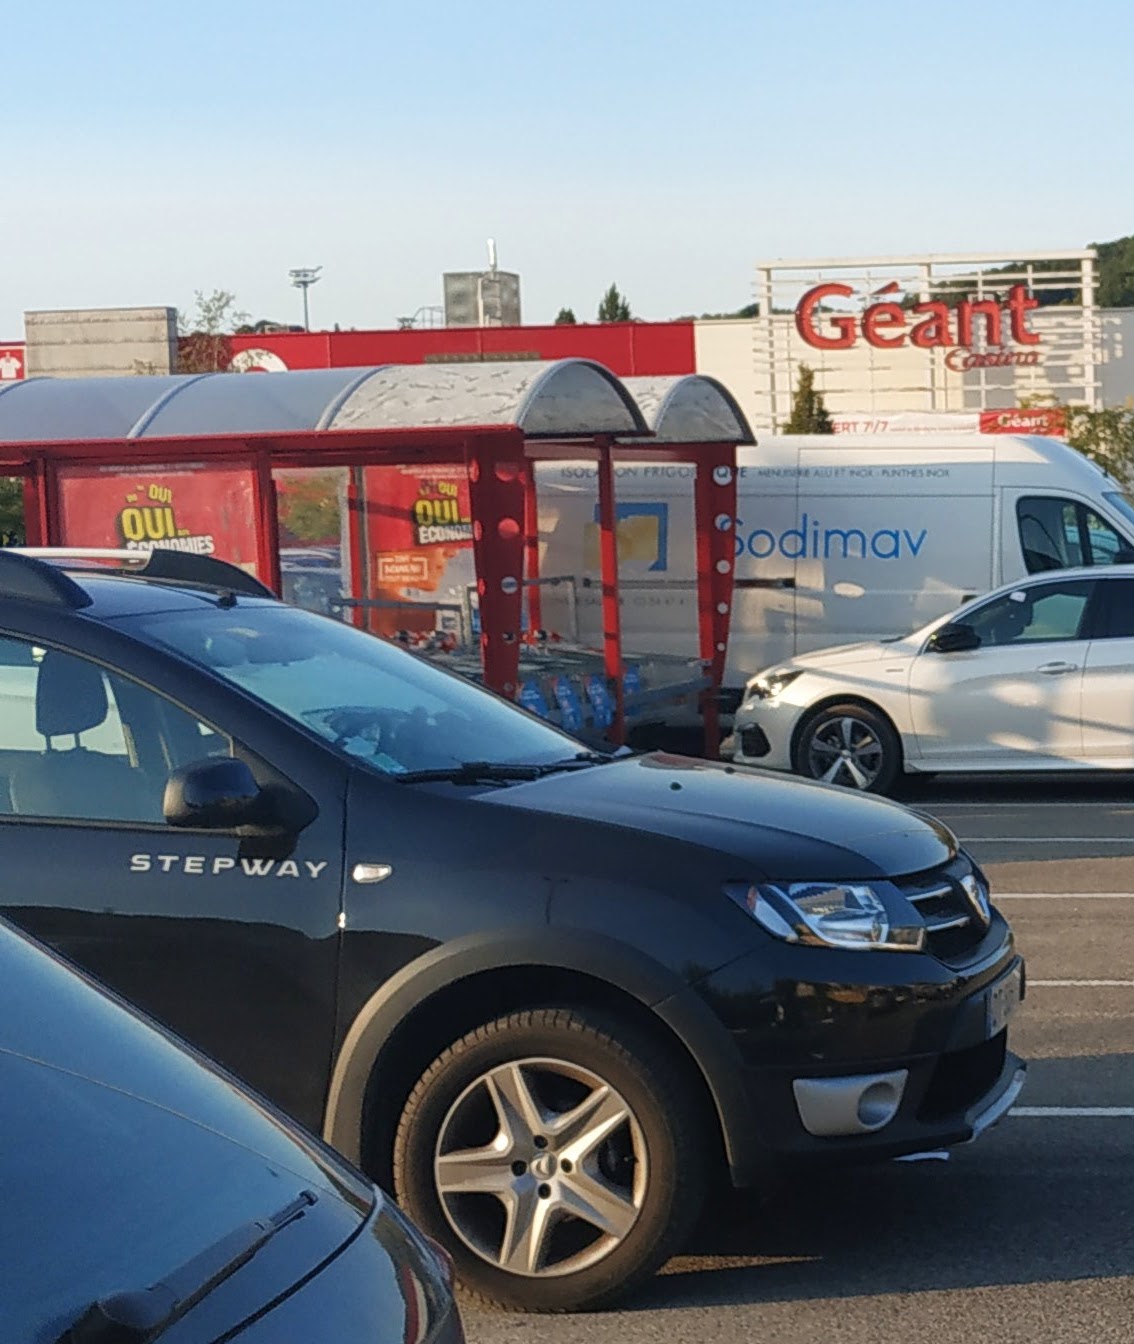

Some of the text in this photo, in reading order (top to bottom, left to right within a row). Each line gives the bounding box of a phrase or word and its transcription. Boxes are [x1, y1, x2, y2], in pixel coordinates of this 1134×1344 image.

[794, 281, 1041, 350] Géant
[149, 484, 172, 504] OUI
[121, 508, 175, 541] OUI
[415, 499, 459, 525] OUI
[129, 854, 328, 879] STEPWAY
